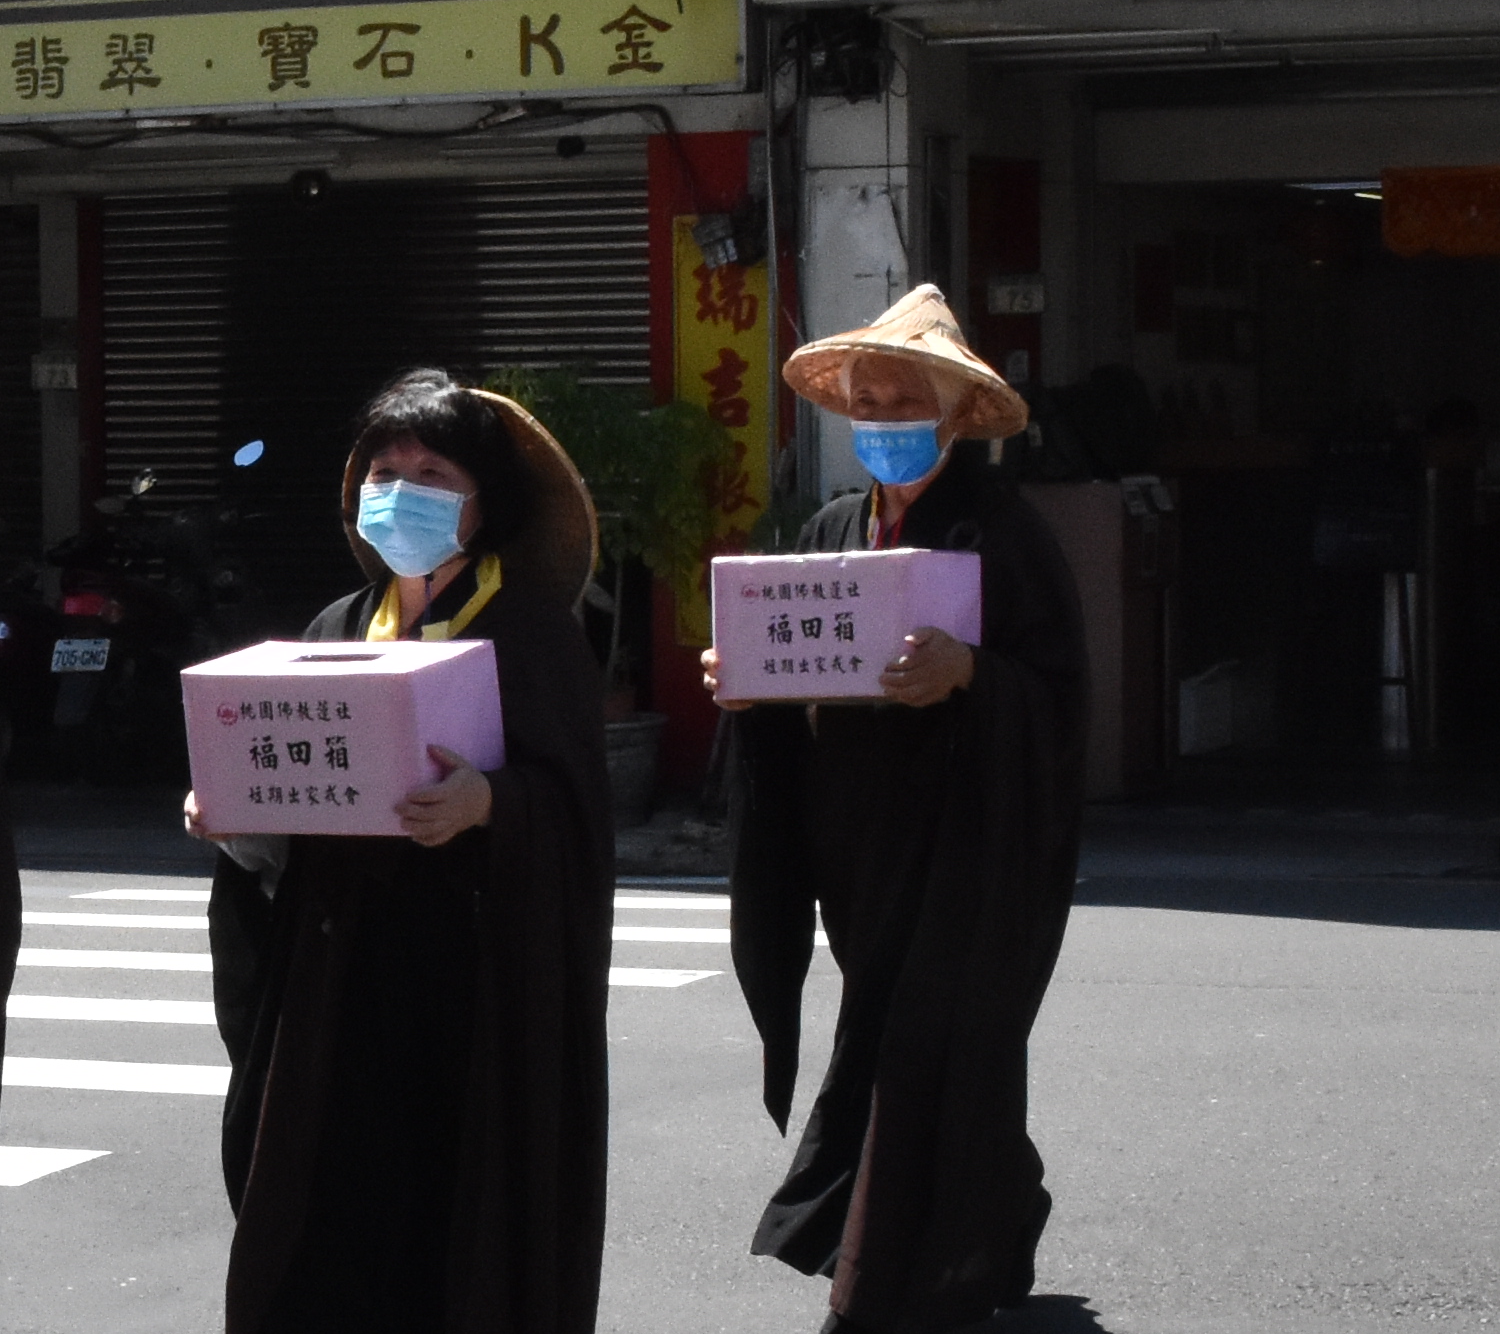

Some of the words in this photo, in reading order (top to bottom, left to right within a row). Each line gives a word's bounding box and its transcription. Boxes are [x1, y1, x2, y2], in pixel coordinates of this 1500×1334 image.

[767, 612, 855, 645] 福田箱
[249, 735, 349, 771] 福田箱
